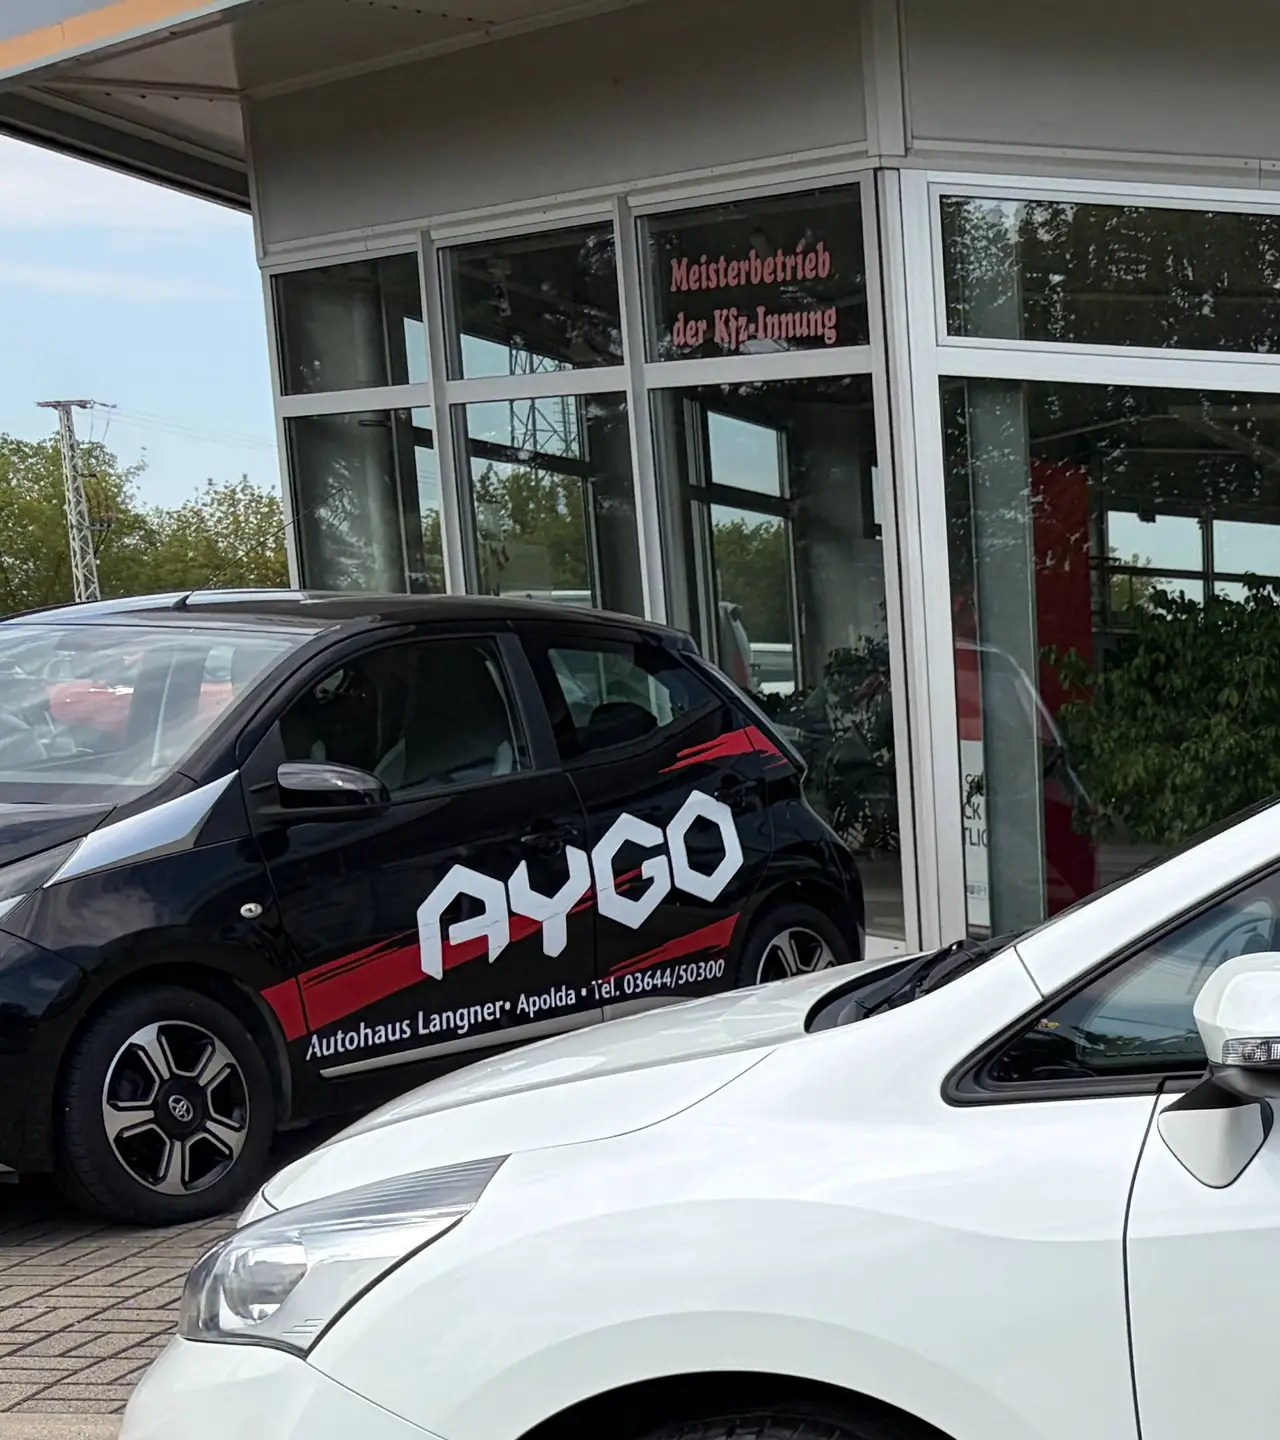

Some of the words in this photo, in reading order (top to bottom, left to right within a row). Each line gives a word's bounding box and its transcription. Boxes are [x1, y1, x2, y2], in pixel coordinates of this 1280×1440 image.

[670, 241, 831, 292] Meisterbetrieb
[672, 311, 707, 347] der
[713, 305, 837, 351] Kfz-Innung
[416, 789, 744, 981] AYGO
[305, 1018, 411, 1061] Autohaus
[516, 984, 576, 1018] Apolda
[591, 976, 620, 1000] Tel.
[623, 958, 725, 994] 03644/50300
